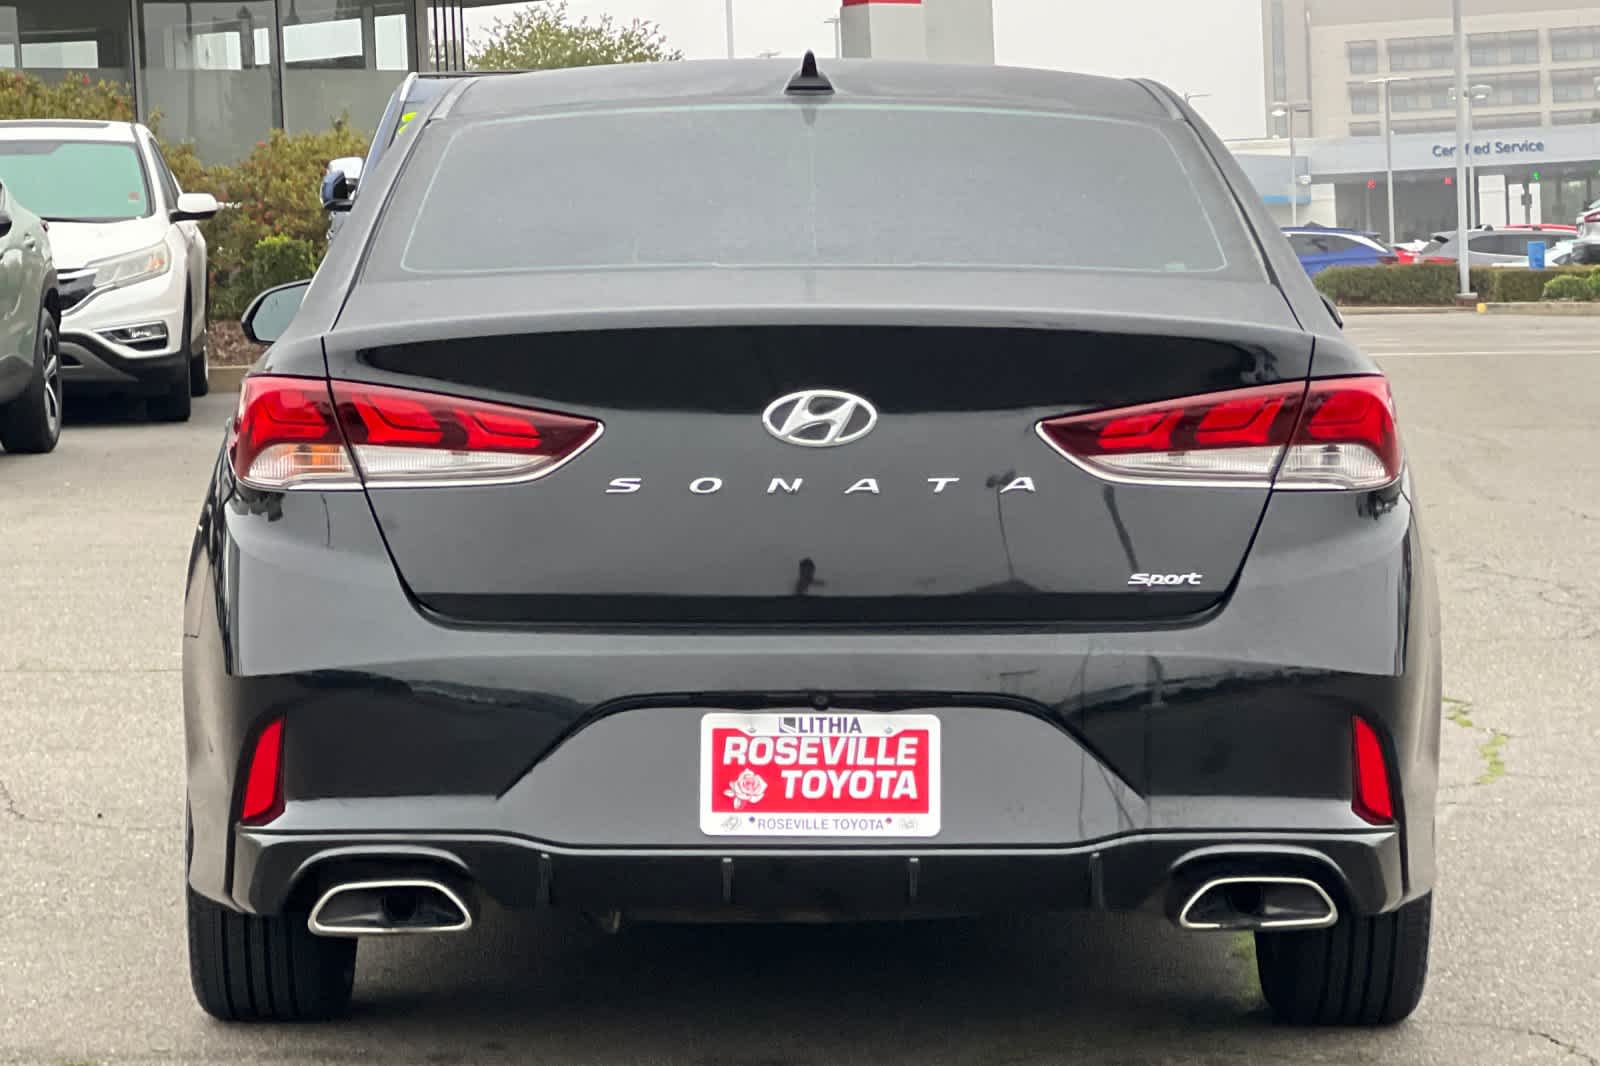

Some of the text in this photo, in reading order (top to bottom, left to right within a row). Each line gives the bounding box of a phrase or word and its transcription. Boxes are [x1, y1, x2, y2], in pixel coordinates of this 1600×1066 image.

[1432, 140, 1544, 157] Cerfed Service
[606, 477, 1036, 494] SONATA
[1128, 572, 1203, 587] Sport
[798, 716, 862, 734] LITHIA
[722, 736, 918, 766] ROSEVILLE
[781, 770, 918, 799] TOYOTA
[757, 818, 884, 831] ROSEVILLE TOYOTA
